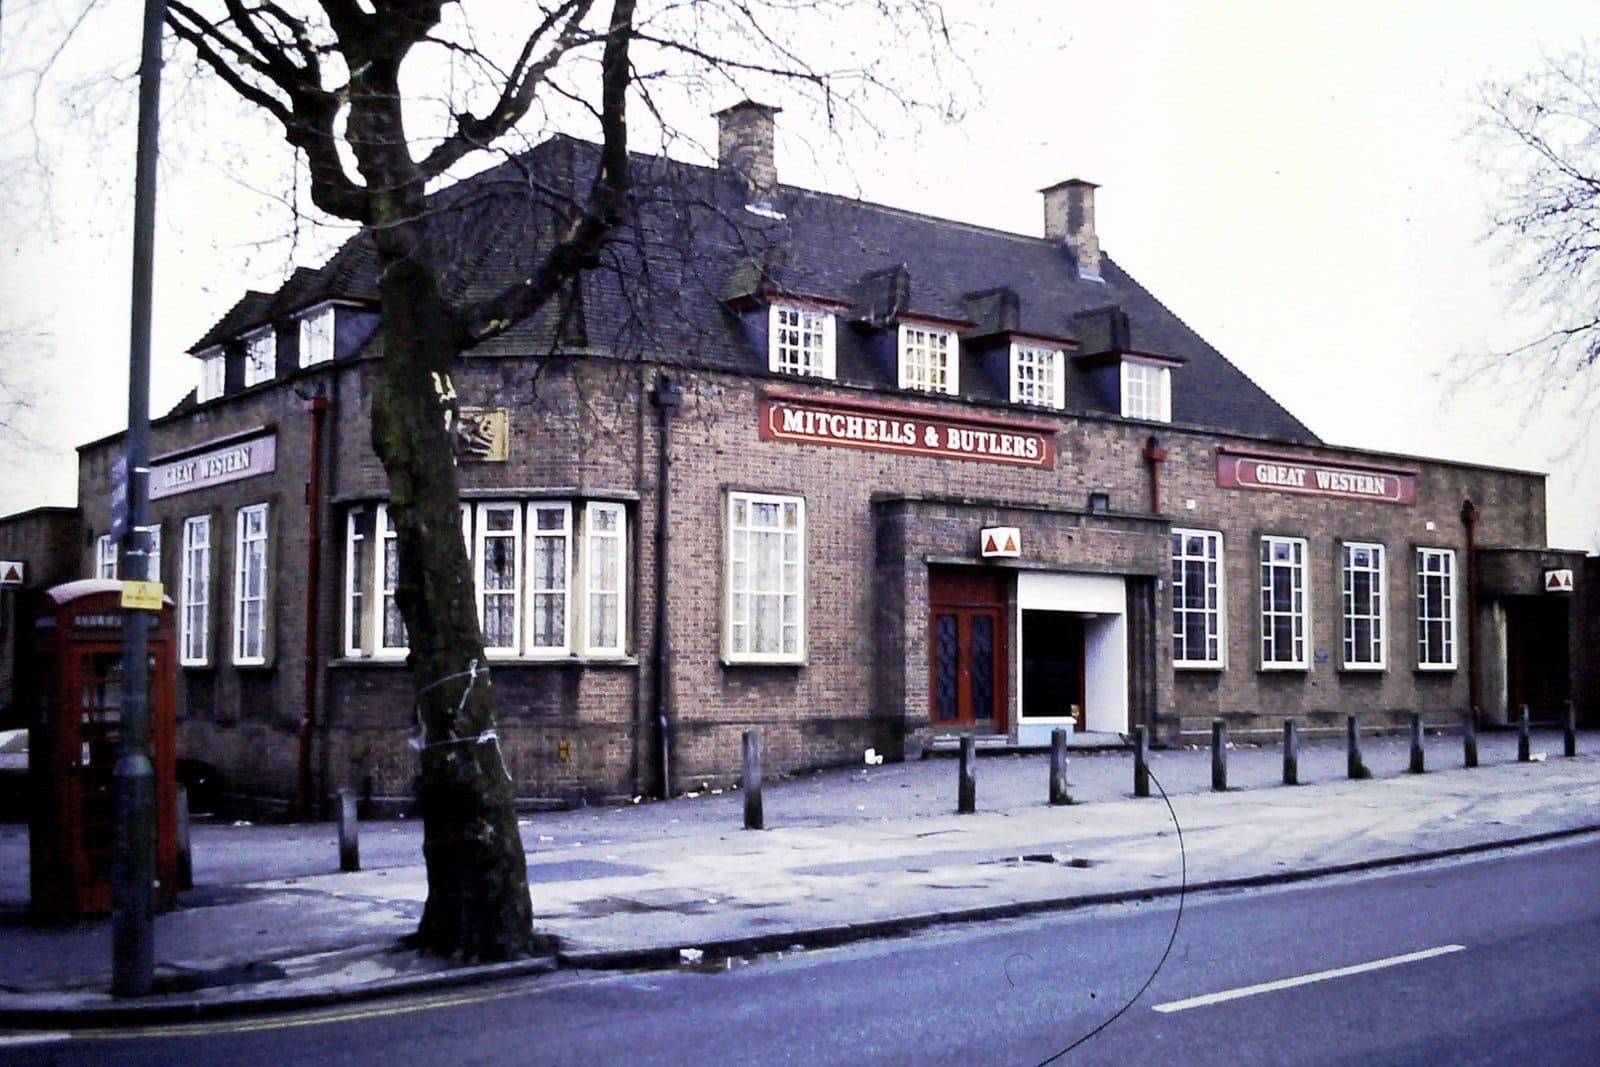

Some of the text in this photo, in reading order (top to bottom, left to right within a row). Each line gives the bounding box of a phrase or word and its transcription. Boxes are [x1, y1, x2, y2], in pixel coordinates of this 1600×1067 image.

[782, 408, 1038, 459] MITCHELLS & BUTLERS
[164, 447, 252, 489] GREAT WESTERN
[1255, 463, 1386, 494] GREAT WESTERN
